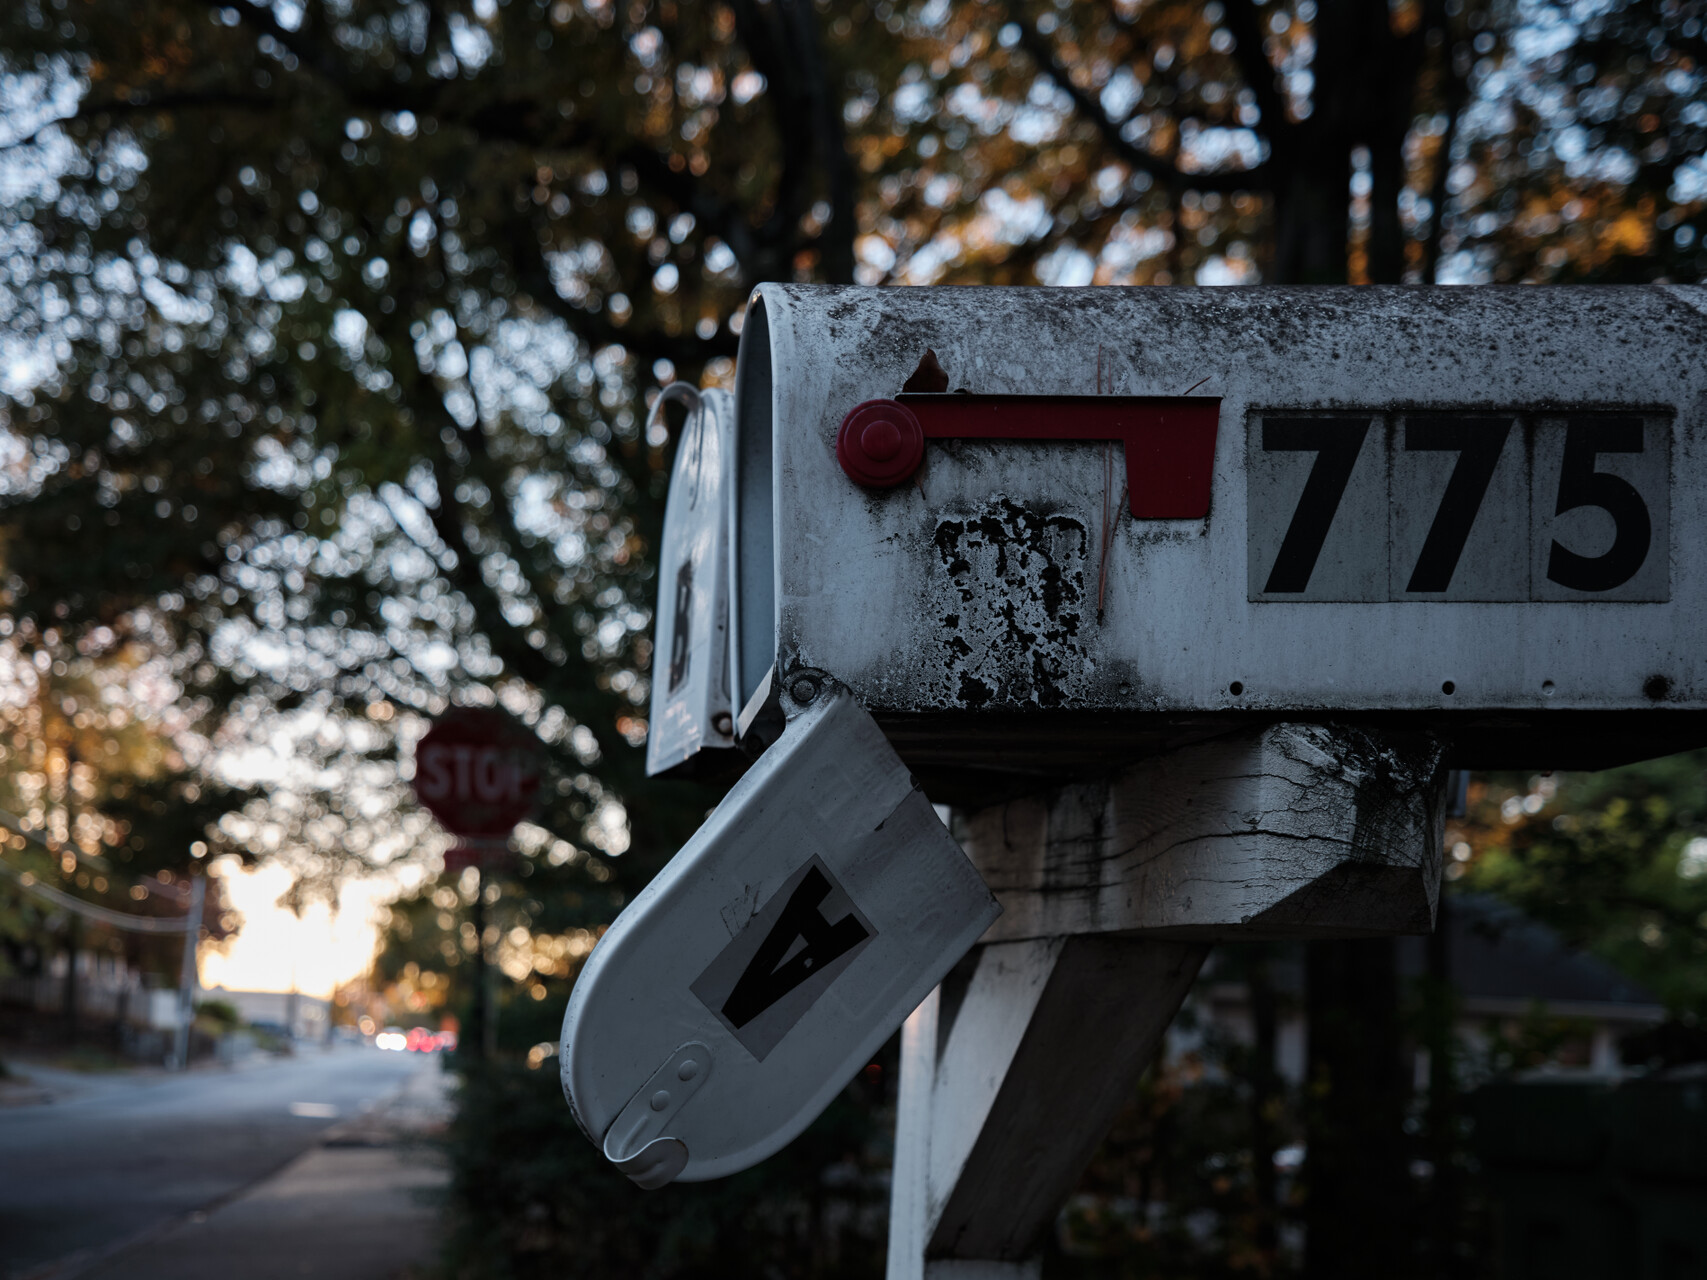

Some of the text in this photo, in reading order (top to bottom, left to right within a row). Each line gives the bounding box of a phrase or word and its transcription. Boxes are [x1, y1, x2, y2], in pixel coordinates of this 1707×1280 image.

[1262, 417, 1652, 593] 775
[421, 742, 538, 801] STOP
[721, 864, 870, 1030] A
